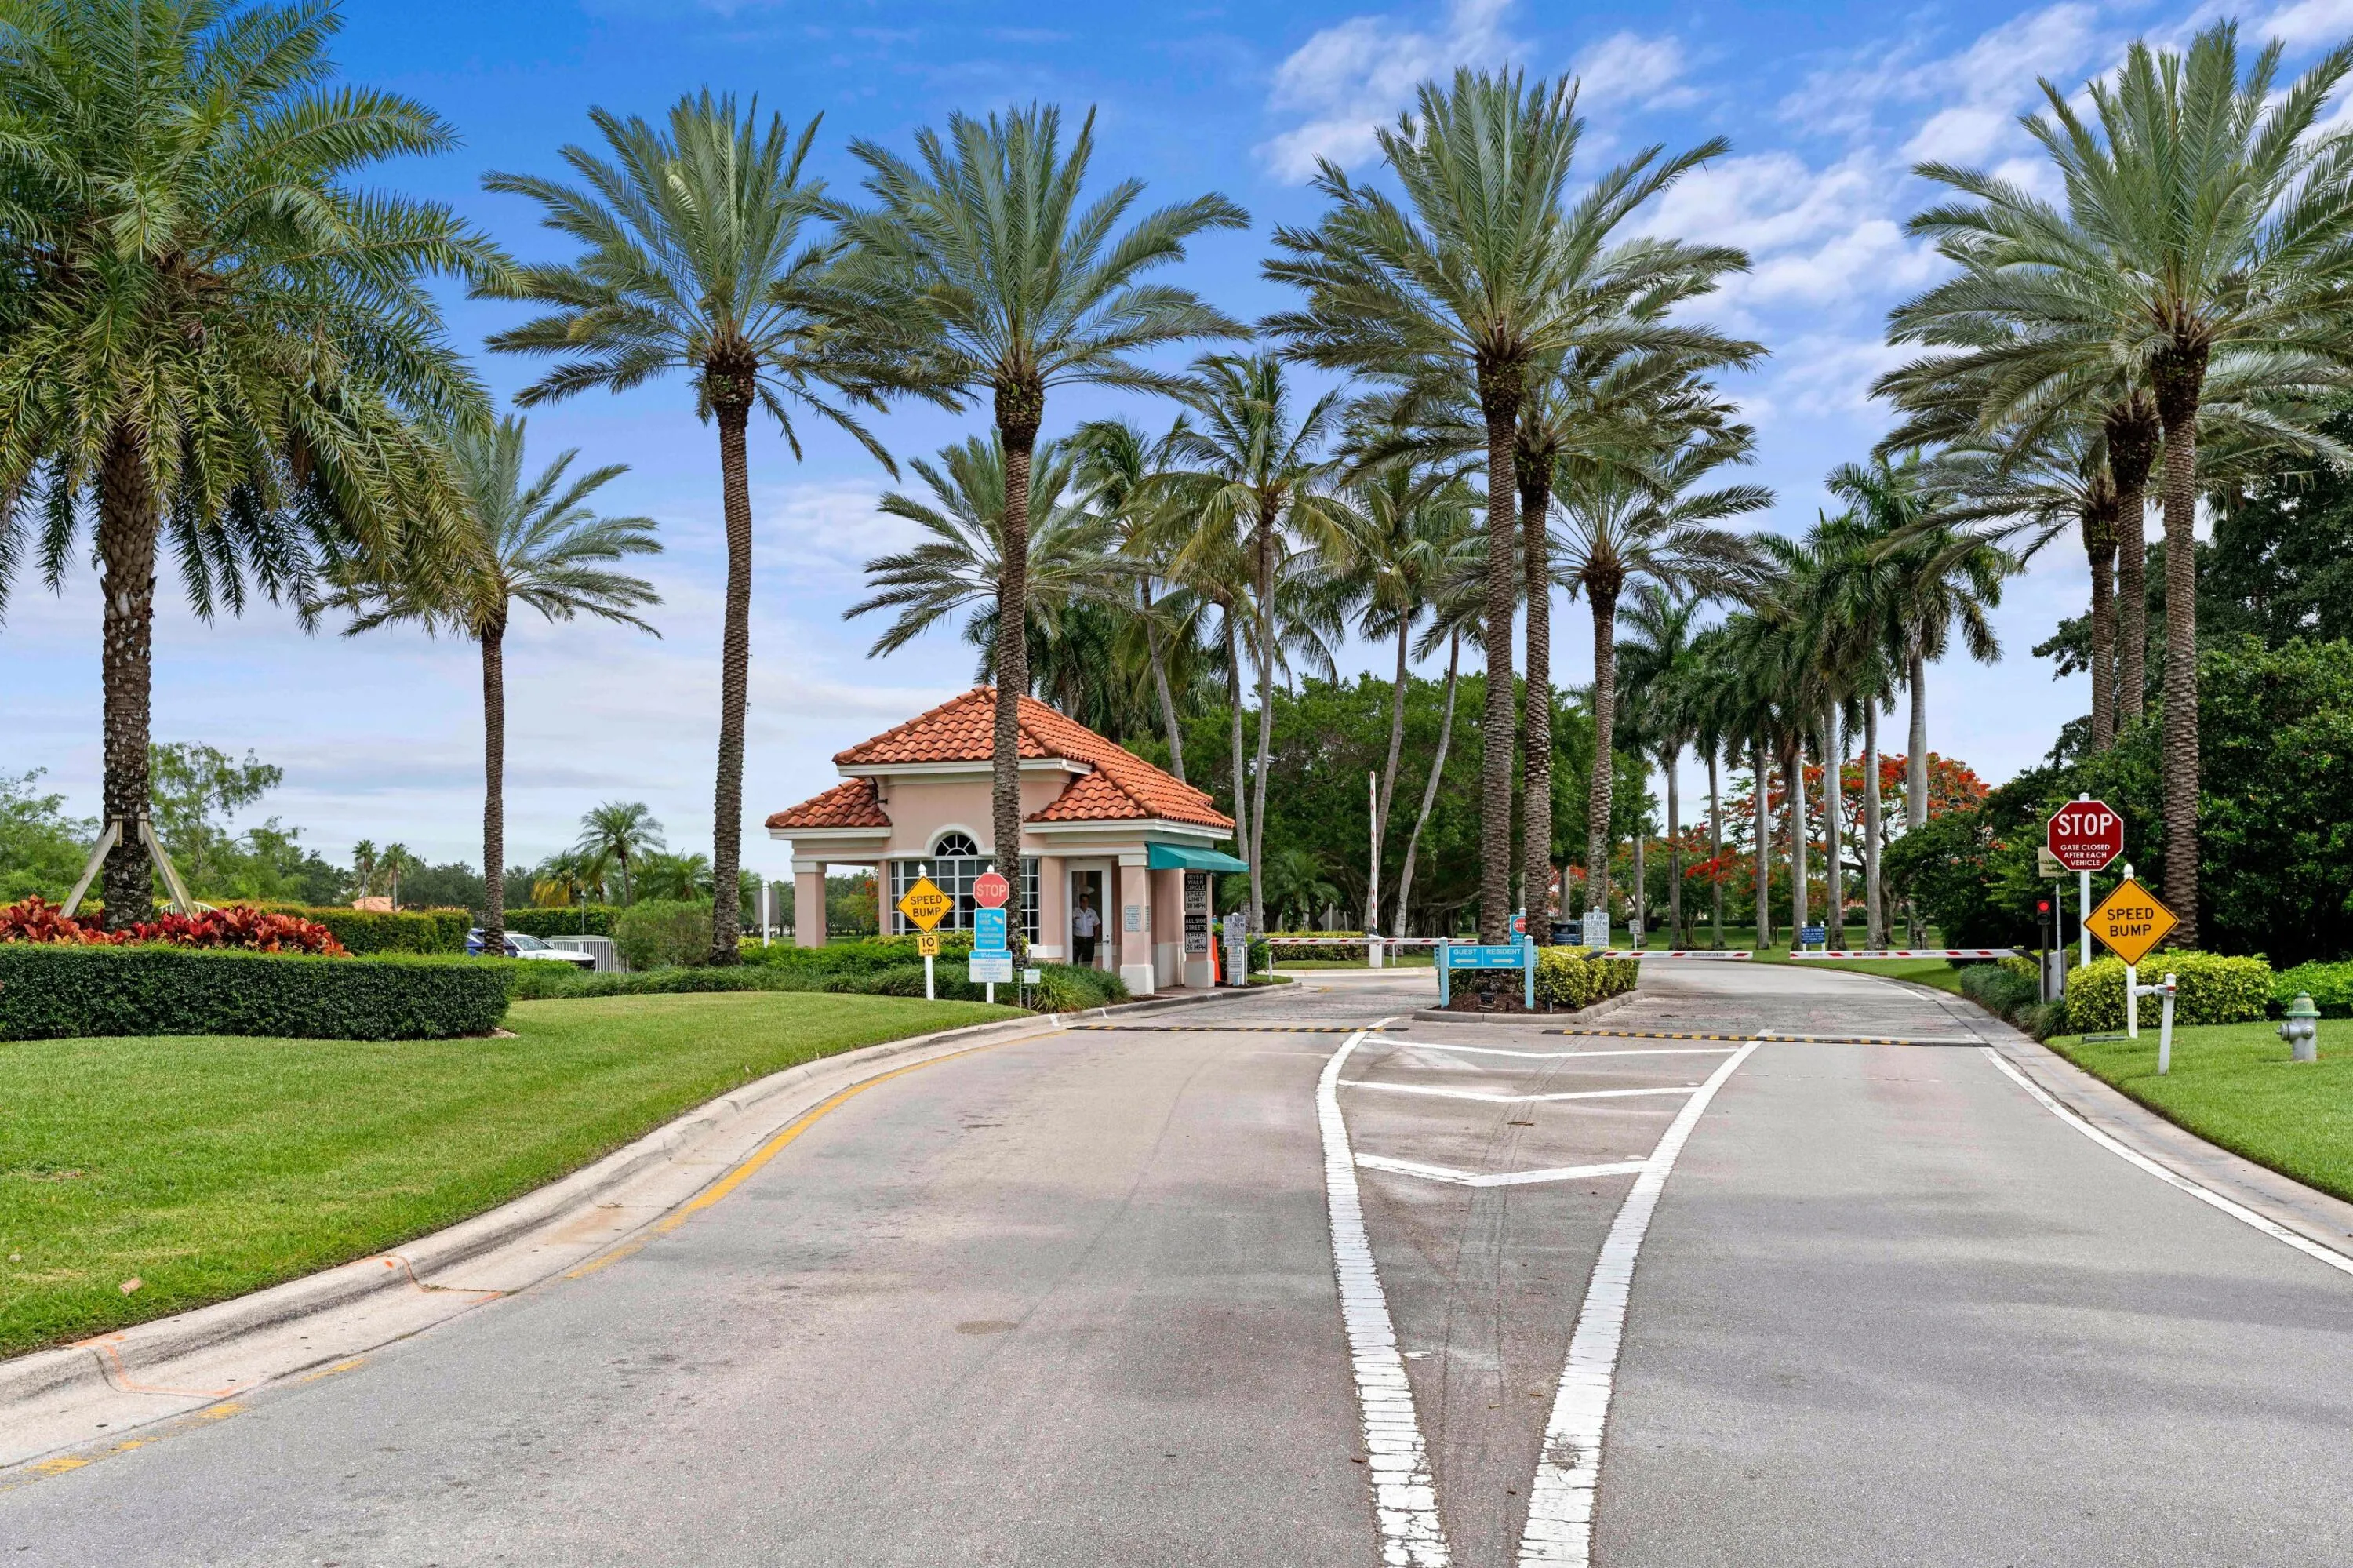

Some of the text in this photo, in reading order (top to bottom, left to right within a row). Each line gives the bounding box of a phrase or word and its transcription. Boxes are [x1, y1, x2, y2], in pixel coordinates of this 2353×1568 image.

[2057, 813, 2113, 835] STOP
[976, 884, 1006, 897] STOP
[911, 895, 943, 905] SPEED
[913, 907, 941, 917] BUMP
[2107, 908, 2154, 921] SPEED
[2110, 924, 2151, 937] BUMP
[922, 937, 934, 947] 10
